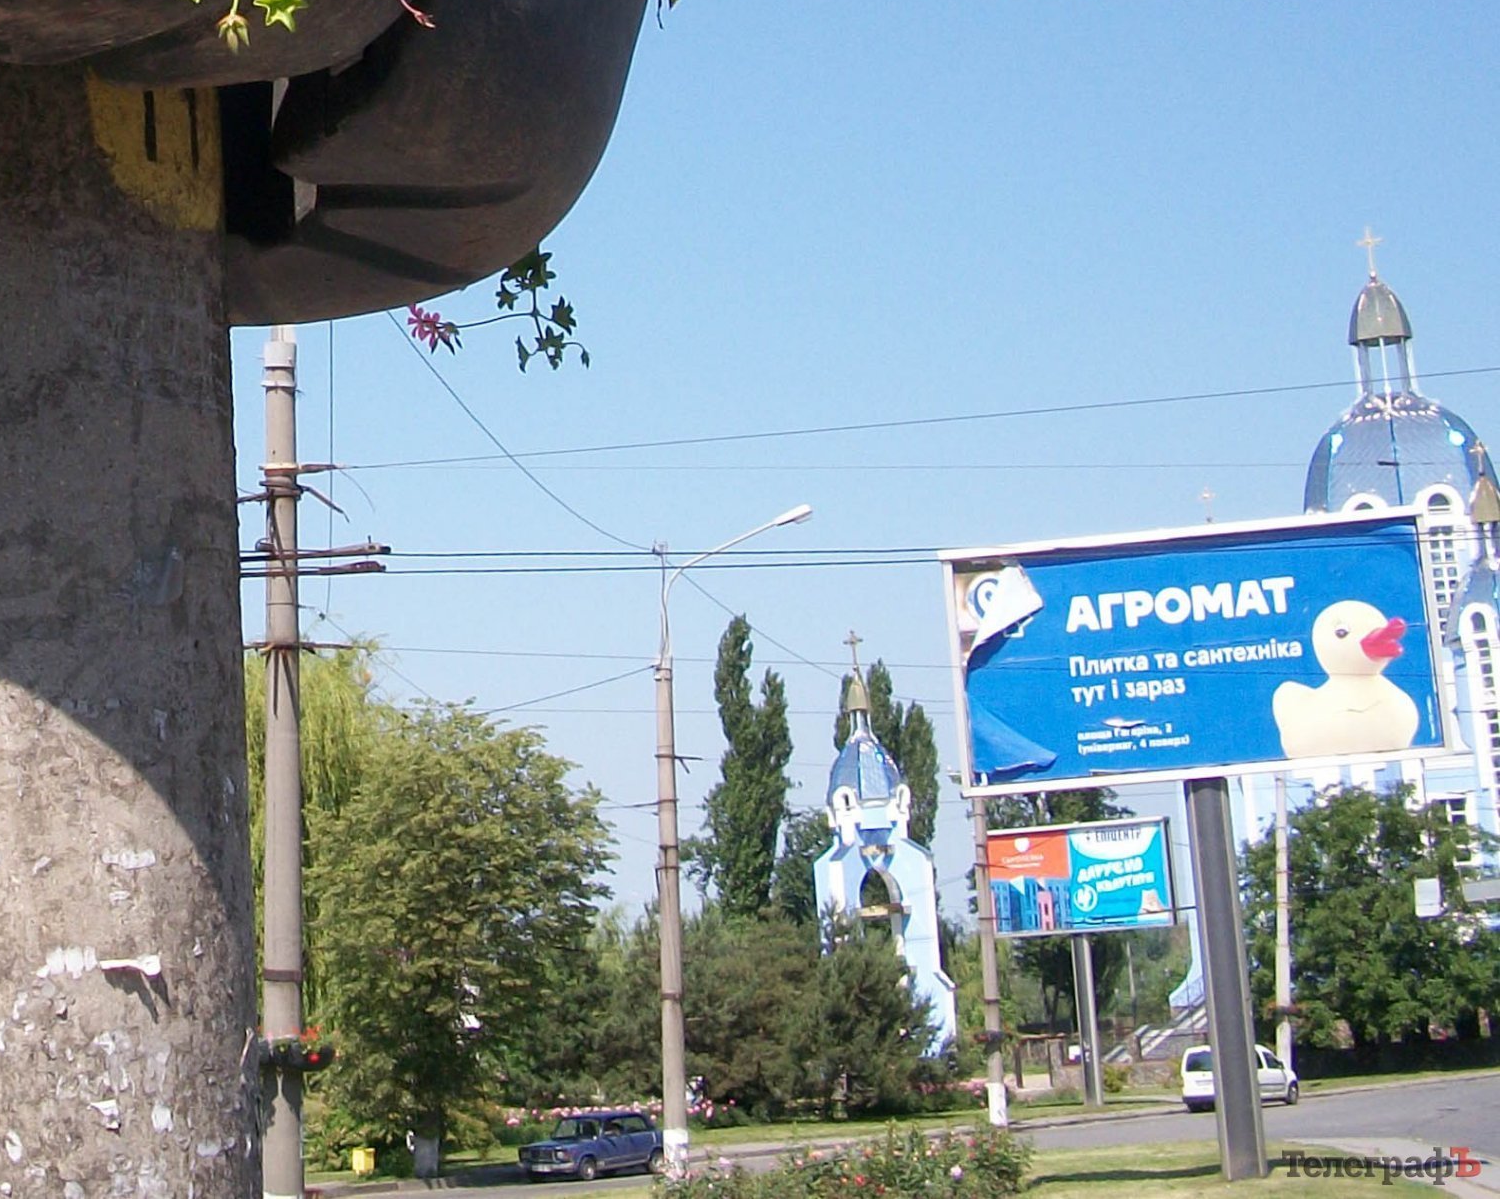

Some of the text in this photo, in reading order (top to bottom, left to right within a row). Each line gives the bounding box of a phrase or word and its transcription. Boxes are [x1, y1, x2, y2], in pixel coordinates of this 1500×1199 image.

[1066, 576, 1295, 633] АГРОМАТ
[1069, 638, 1303, 677] Плитка та сантехніка
[1071, 677, 1186, 707] тут і зараз
